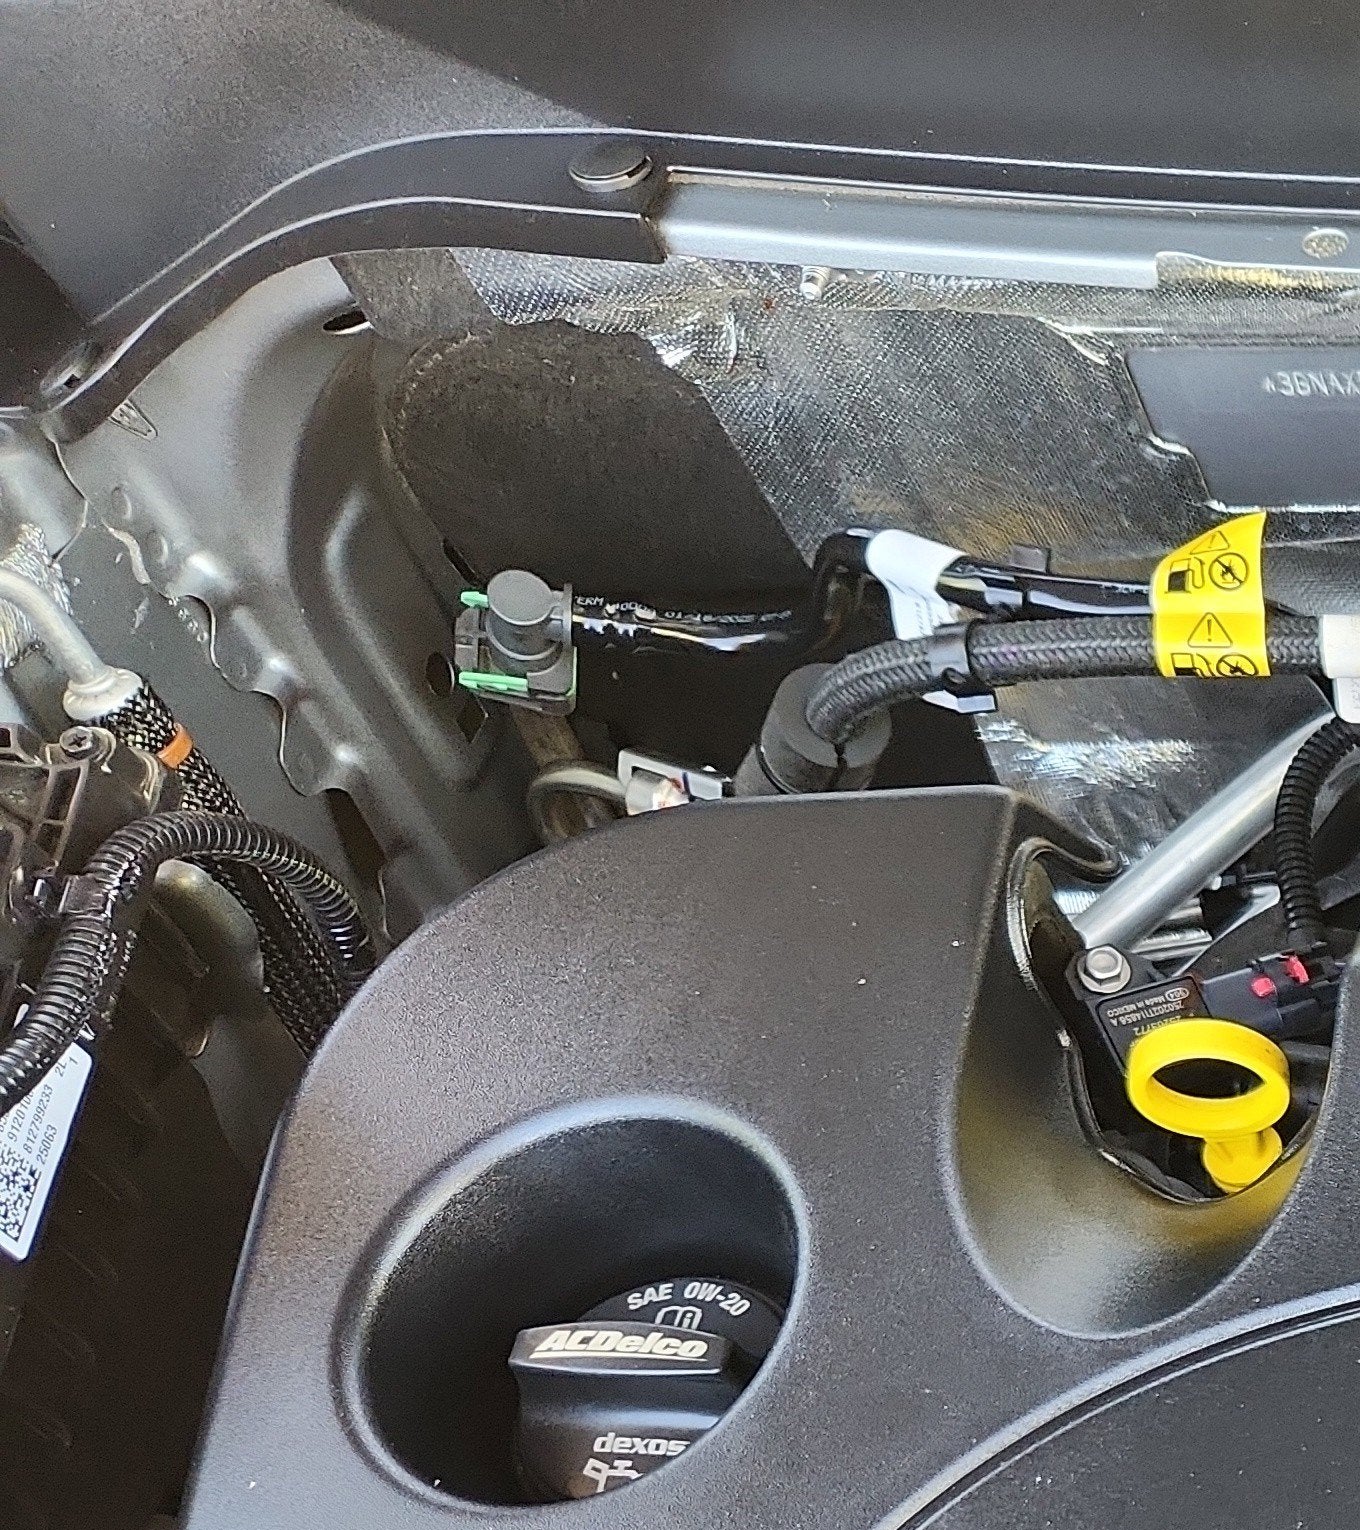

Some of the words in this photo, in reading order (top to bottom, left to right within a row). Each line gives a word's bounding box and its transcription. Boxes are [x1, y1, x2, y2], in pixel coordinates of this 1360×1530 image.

[1107, 1004, 1137, 1018] MEXICO
[23, 1084, 53, 1154] 812799233
[37, 1124, 58, 1166] 25063
[627, 1283, 674, 1310] SAE
[684, 1281, 751, 1317] 0W-20
[535, 1331, 708, 1359] ACDelco
[593, 1433, 691, 1456] dexos
